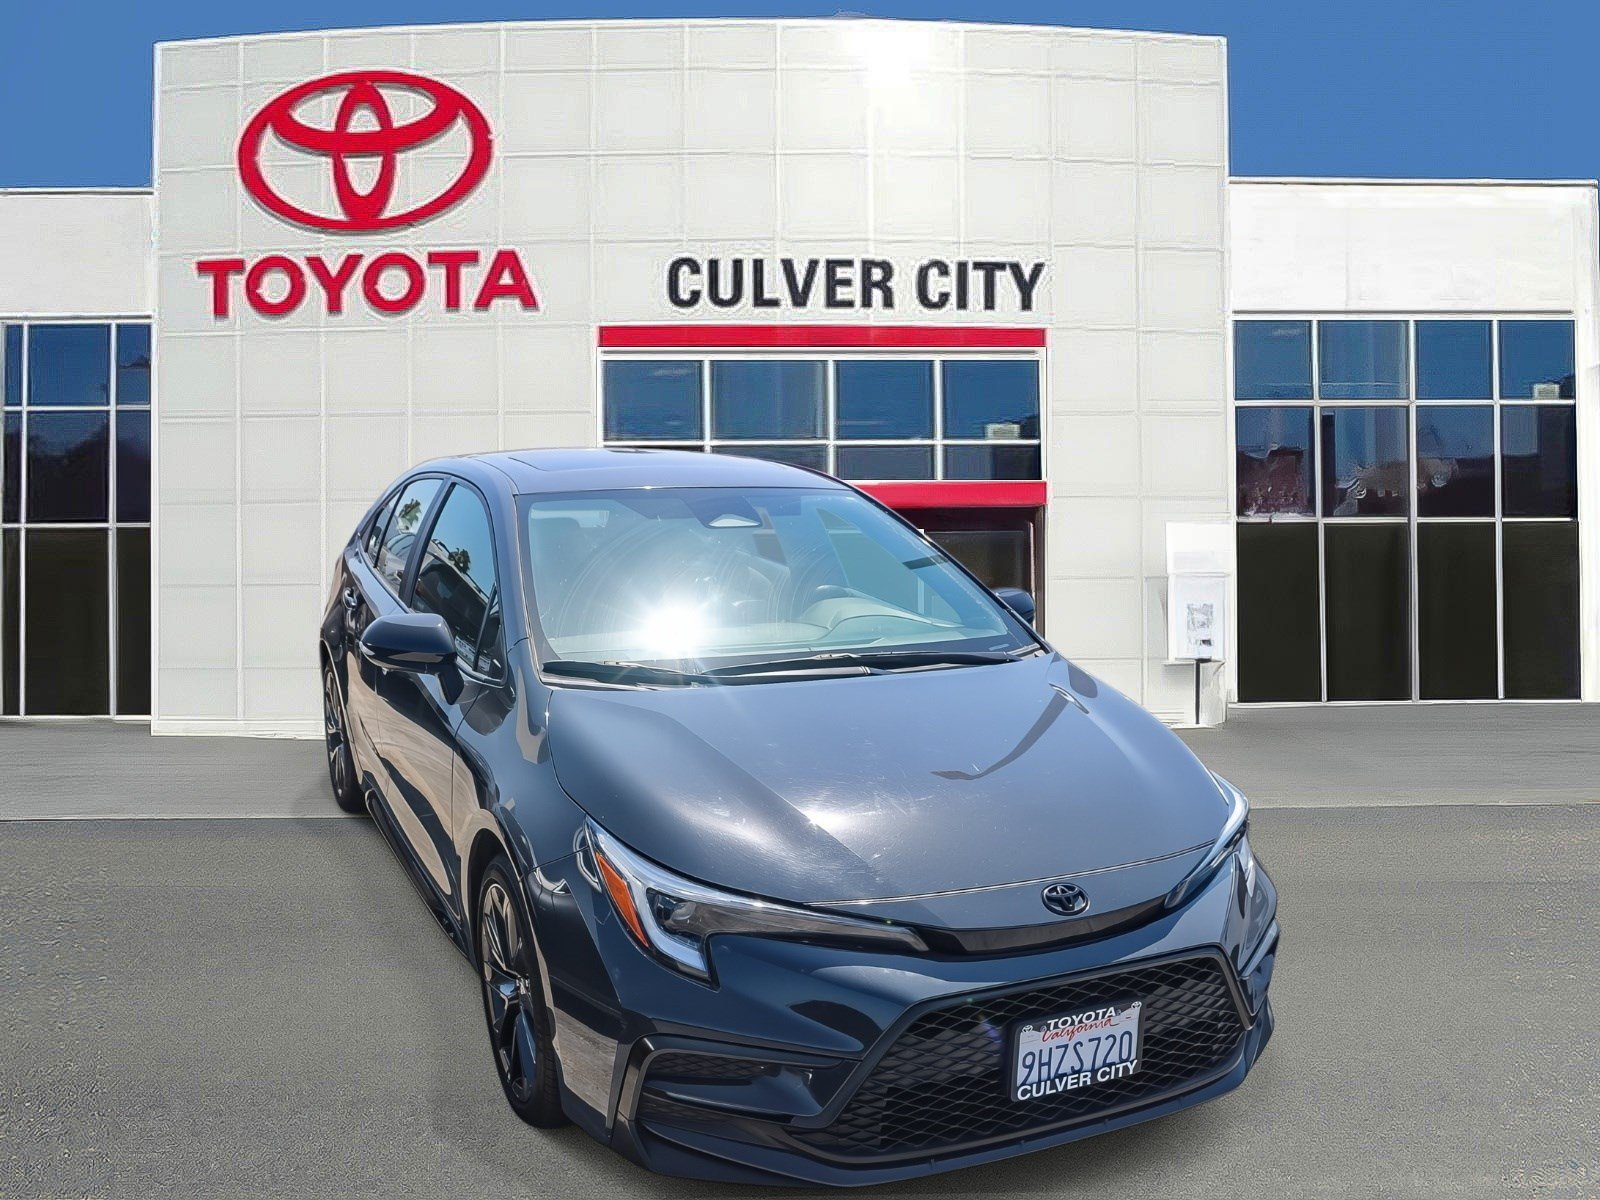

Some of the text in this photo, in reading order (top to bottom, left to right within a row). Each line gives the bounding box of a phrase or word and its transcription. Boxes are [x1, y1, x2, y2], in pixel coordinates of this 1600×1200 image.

[196, 250, 539, 318] TOYOTA
[668, 258, 1045, 310] CULVER CITY
[1042, 1018, 1120, 1043] California
[1047, 1007, 1116, 1031] TOYOTA
[1017, 1060, 1138, 1101] CULVER CITY
[1020, 1030, 1133, 1086] 9HZS720
